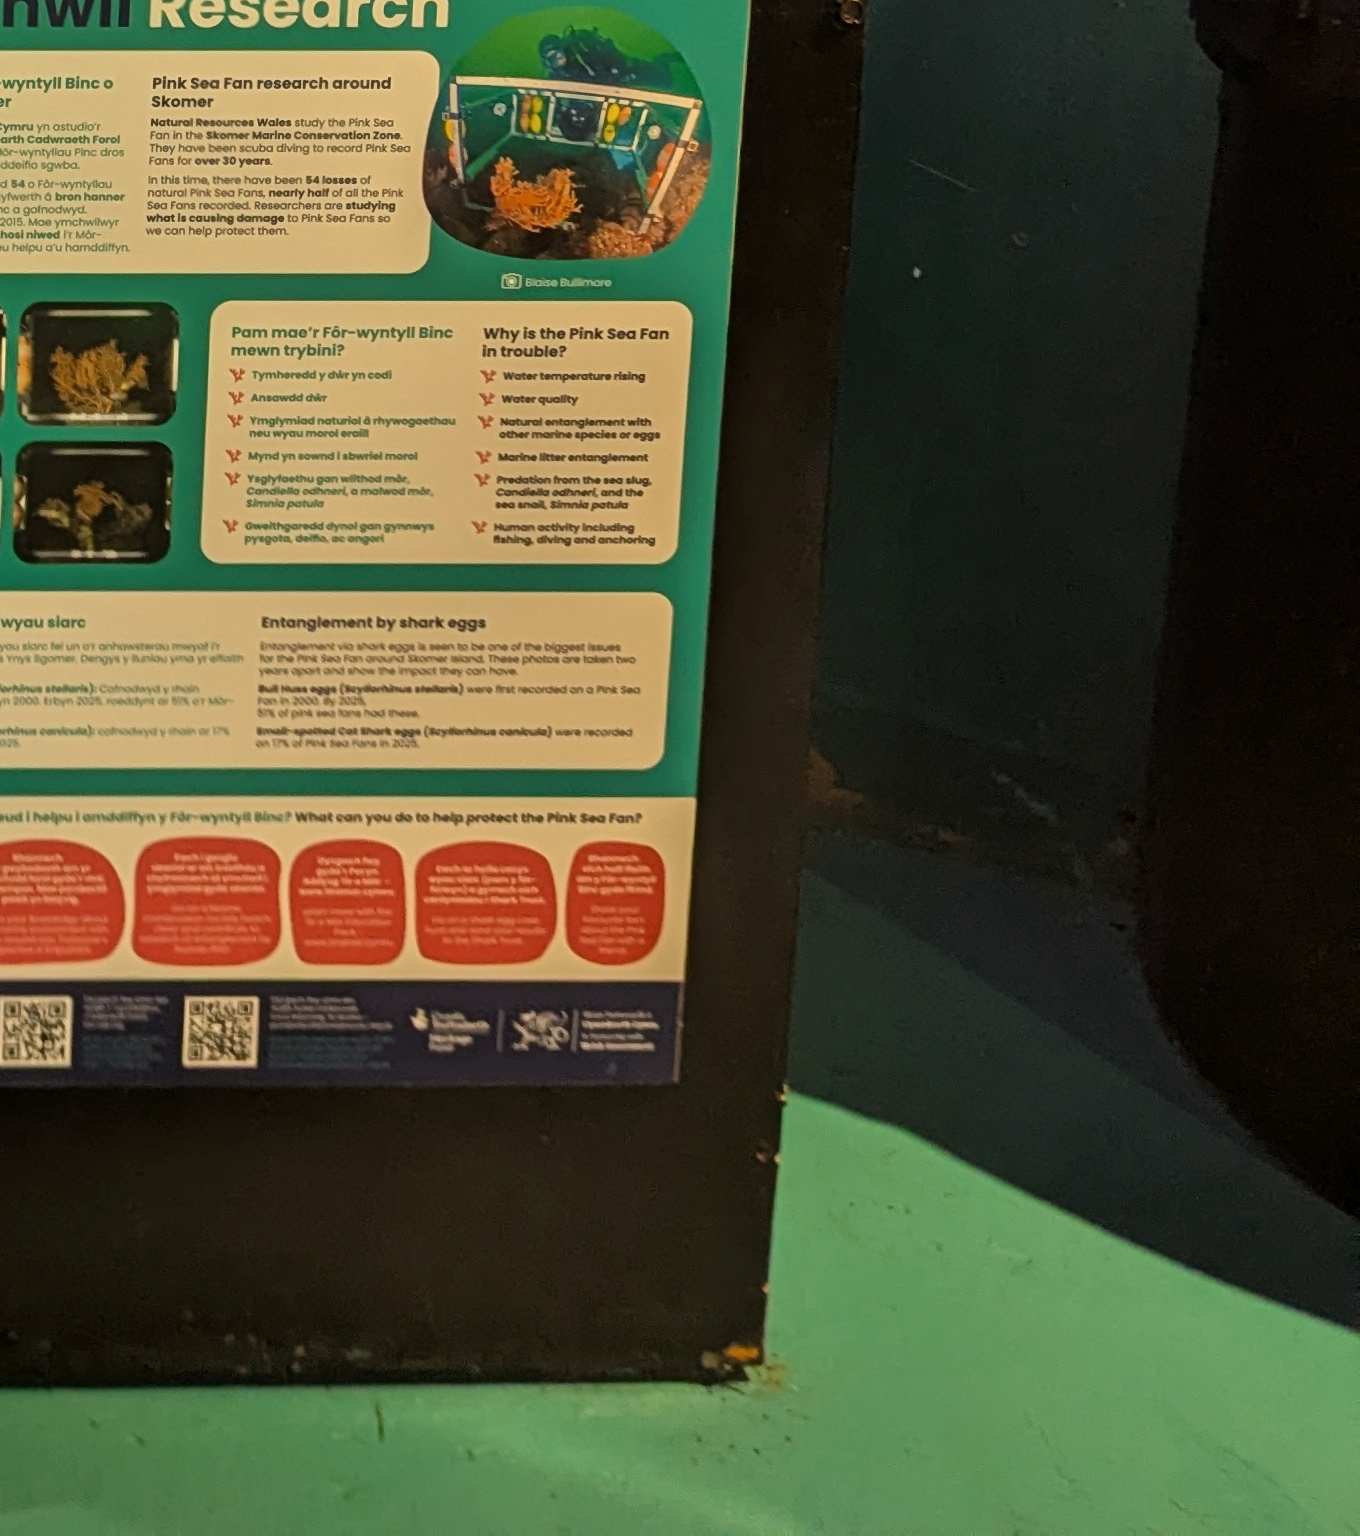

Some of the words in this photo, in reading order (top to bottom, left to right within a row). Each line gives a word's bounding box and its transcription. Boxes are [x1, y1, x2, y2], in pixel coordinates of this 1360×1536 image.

[152, 76, 187, 89] Pink
[190, 77, 219, 89] Sea
[223, 77, 252, 89] Fan
[256, 76, 328, 89] research
[332, 76, 391, 89] around
[151, 95, 213, 107] Skomer
[525, 277, 558, 288] Blaise
[484, 327, 519, 343] Why
[523, 326, 536, 339] is
[540, 327, 566, 339] the
[569, 326, 603, 339] Pink
[607, 328, 636, 339] Sea
[640, 327, 669, 339] Fan
[482, 345, 496, 357] in
[500, 345, 566, 357] trouble?
[501, 395, 536, 403] Water
[538, 394, 578, 405] quality
[261, 616, 372, 632] Entanglement
[376, 616, 396, 631] by
[399, 616, 444, 628] shark
[447, 618, 486, 632] eggs
